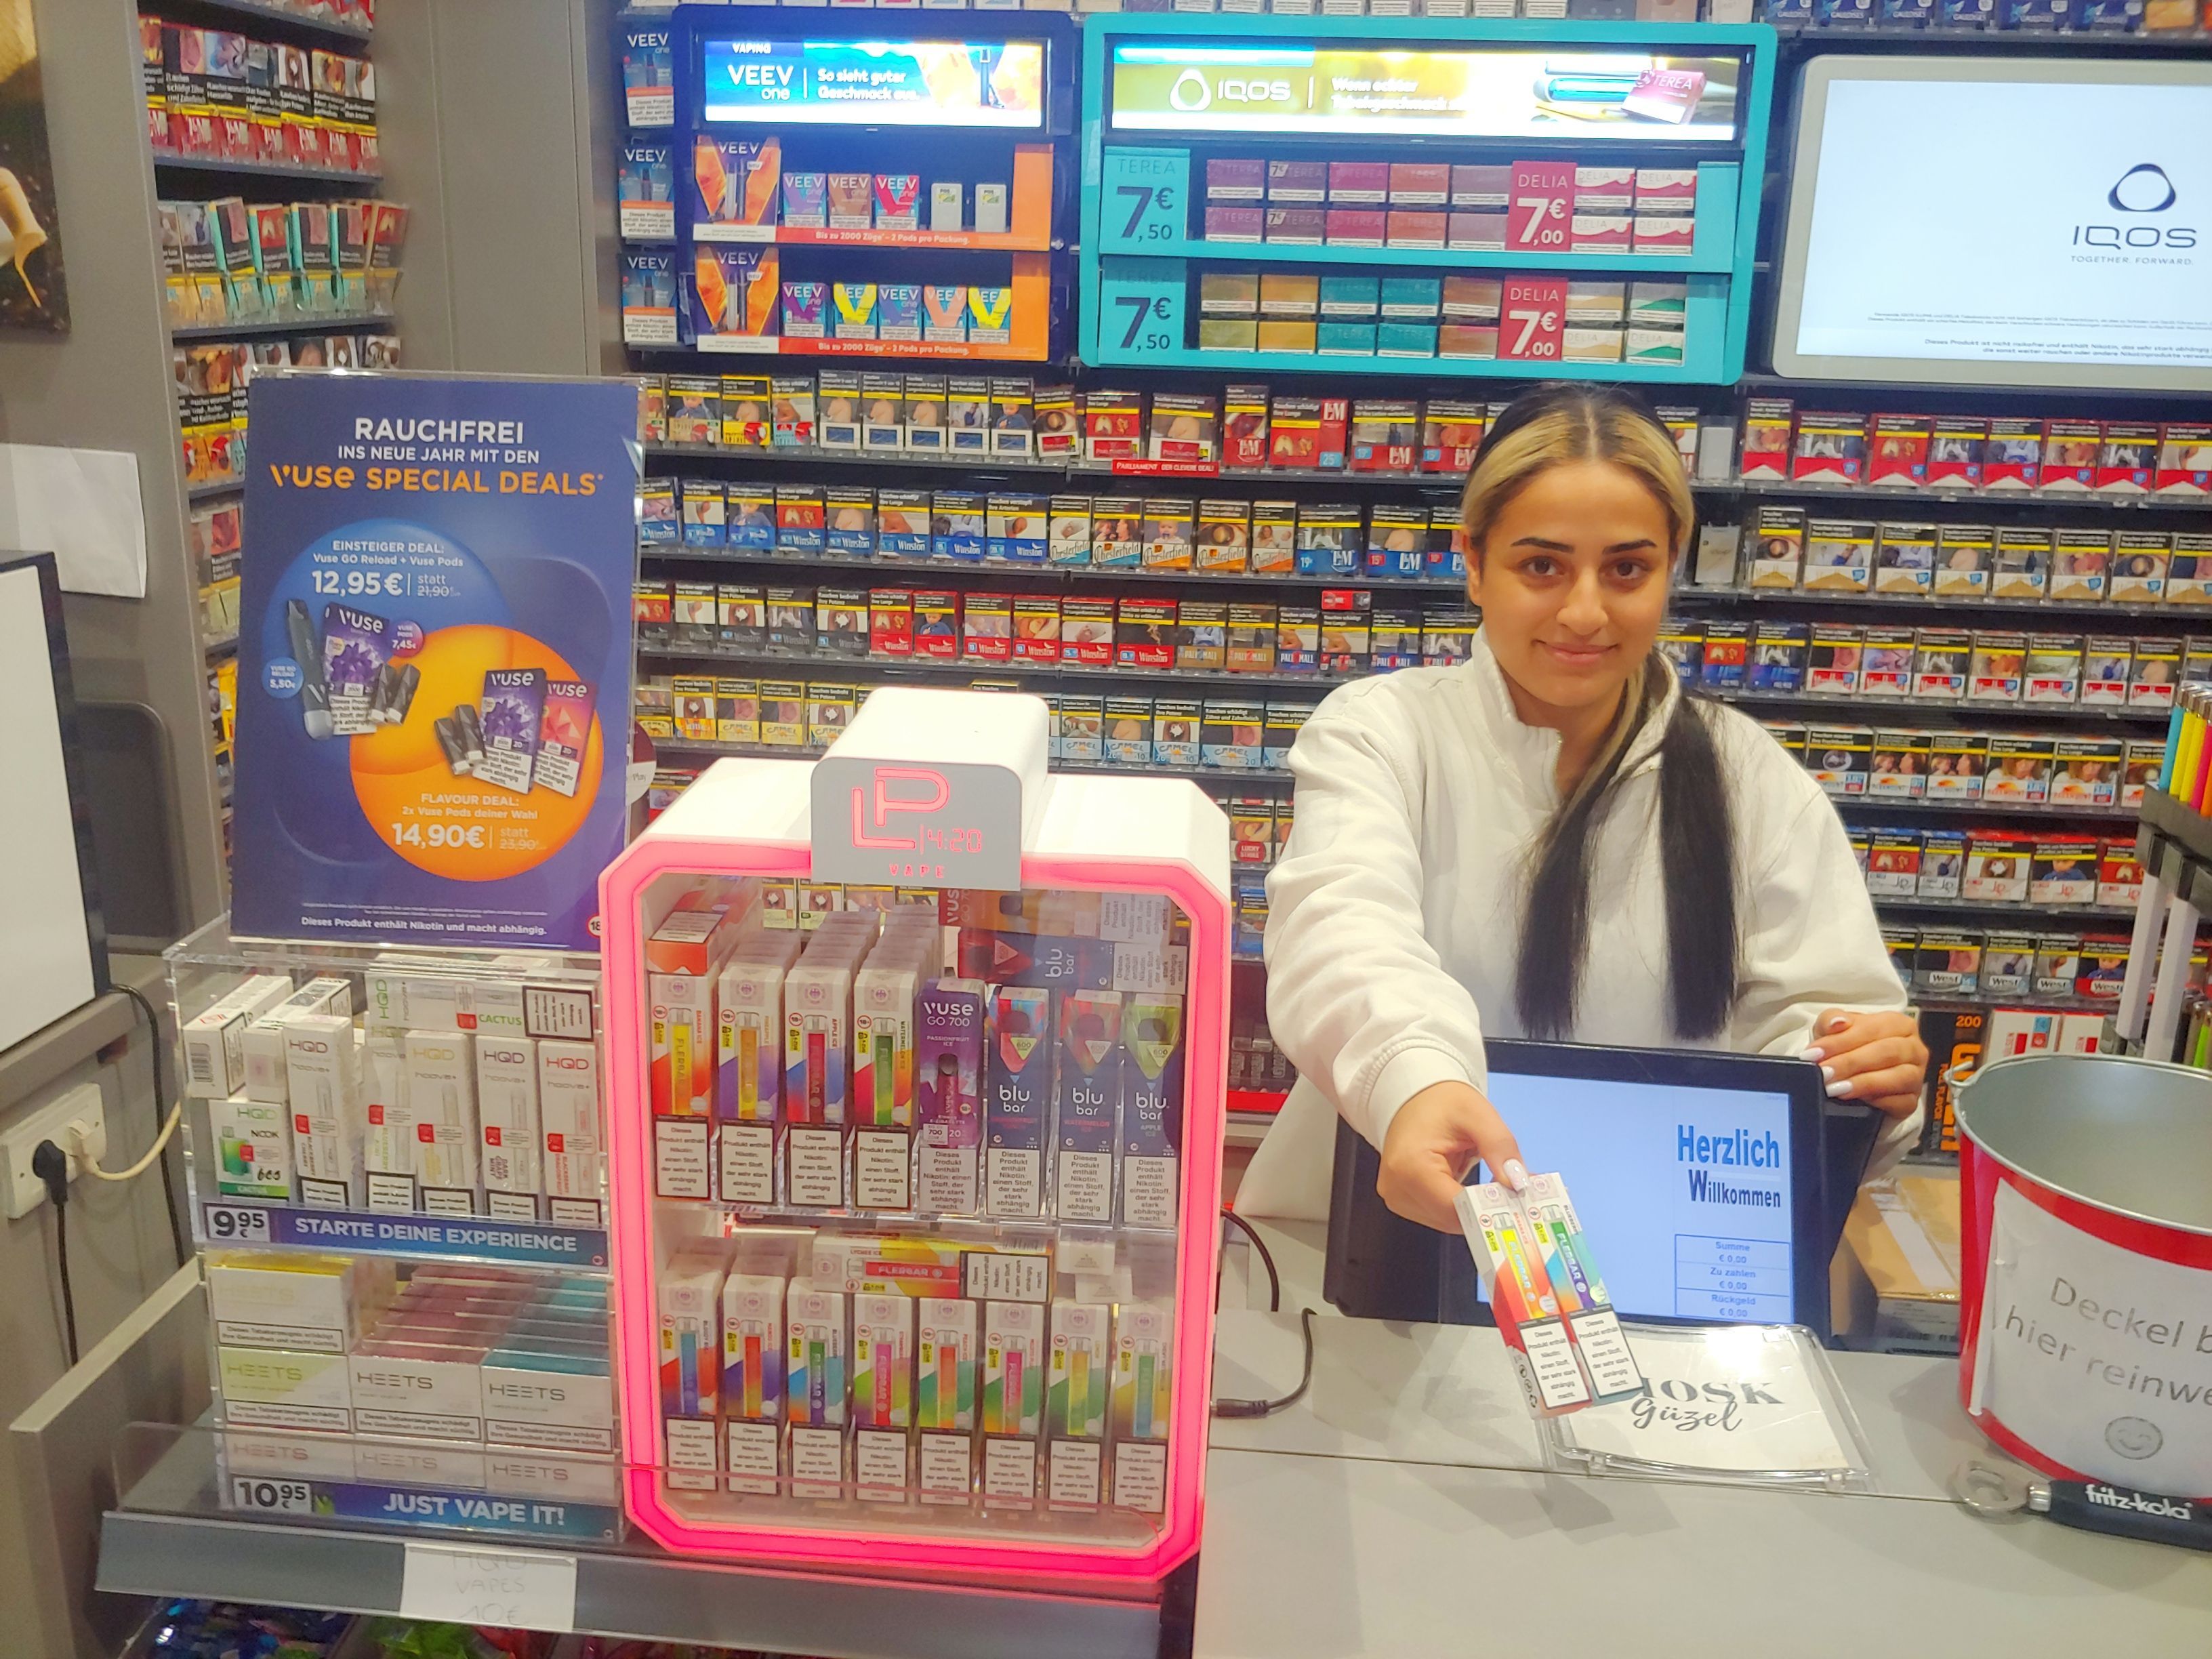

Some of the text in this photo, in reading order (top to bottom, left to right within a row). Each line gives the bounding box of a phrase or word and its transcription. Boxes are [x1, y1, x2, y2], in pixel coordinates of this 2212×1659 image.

[628, 33, 668, 47] VEEV
[732, 43, 771, 54] VAPING
[727, 66, 794, 85] VEEV
[818, 69, 905, 85] So sieht guter
[1654, 75, 1692, 90] TEREA
[762, 87, 790, 100] one
[817, 85, 890, 100] Geschmack
[1218, 81, 1290, 102] IQOS
[624, 149, 666, 163] VEEV
[718, 142, 758, 155] VEEV
[1118, 159, 1176, 174] TEREA
[785, 176, 823, 188] VEEV
[1518, 175, 1568, 188] DELIA
[1118, 186, 1152, 238] 7
[1155, 187, 1173, 209] €
[1517, 198, 1548, 243] 7
[1549, 199, 1566, 220] €
[816, 232, 827, 240] Bis
[831, 232, 838, 241] zu
[840, 232, 861, 241] 2000
[893, 233, 897, 243] 2
[899, 234, 918, 243] Pods
[920, 236, 931, 245] pro
[934, 235, 970, 247] Packung.
[2073, 226, 2196, 249] IQOS
[628, 256, 669, 269] VEEV
[2071, 256, 2194, 265] TOGETHER. FORWARD.
[1510, 287, 1559, 302] DELIA
[1115, 297, 1151, 348] 7
[1153, 298, 1171, 319] €
[1509, 311, 1539, 354] 7
[1540, 311, 1557, 331] €
[355, 417, 523, 444] RAUCHFREI
[339, 446, 539, 464] INS NEUE JAHR MIT DEN
[1117, 463, 1158, 471] PARLIAMENT
[367, 469, 489, 493] SPECIAL
[333, 541, 444, 554] EINSTEIGER DEAL:
[898, 541, 925, 551] Winston
[1017, 546, 1043, 556] Winston
[1094, 543, 1141, 563] Chesterfield
[313, 554, 337, 563] Vuse
[341, 555, 357, 564] GO
[361, 555, 396, 565] Reload
[410, 556, 434, 566] Vuse
[438, 558, 463, 567] Pods
[418, 574, 446, 584] statt
[979, 644, 1006, 655] Winston
[1139, 651, 1168, 662] Winston
[422, 794, 519, 806] FLAVOUR DEAL:
[403, 806, 537, 819] 2x Vuse Pods deiner Wahl
[392, 823, 485, 848] 14,90€
[501, 827, 529, 838] statt
[889, 864, 945, 878] VAPE
[302, 916, 547, 936] Dieses Produkt enthält Nikotin und macht abhängig.
[1932, 974, 1959, 983] West
[2041, 979, 2066, 989] West
[479, 1014, 523, 1027] CACTUS
[927, 1017, 970, 1026] GO 700
[1956, 1017, 1982, 1027] 200
[484, 1050, 525, 1065] HQD
[546, 1057, 589, 1071] HQD
[1000, 1085, 1030, 1101] blu
[1136, 1092, 1167, 1109] blu
[1004, 1102, 1025, 1113] bar
[1140, 1109, 1162, 1120] bar
[1677, 1125, 1780, 1168] Herzlich
[1688, 1169, 1781, 1208] Willkommen
[213, 1211, 236, 1239] 9
[239, 1212, 265, 1229] 95
[295, 1219, 577, 1252] STARTE DEINE EXPERIENCE
[1715, 1242, 1750, 1251] Summe
[1711, 1267, 1755, 1277] Zu zahlen
[1712, 1294, 1756, 1305] Rückgeld
[2051, 1277, 2184, 1347] Deckel
[2006, 1305, 2076, 1361] hier
[357, 1372, 433, 1389] HEETS
[489, 1384, 565, 1401] HEETS
[1640, 1376, 1783, 1405] IOSK
[1631, 1398, 1742, 1431] Güzel
[238, 1483, 276, 1507] 10
[281, 1485, 306, 1501] 95
[2086, 1485, 2190, 1520] fritz-kola
[383, 1494, 564, 1525] JUST VAPE IT!
[456, 1578, 525, 1594] VAPES
